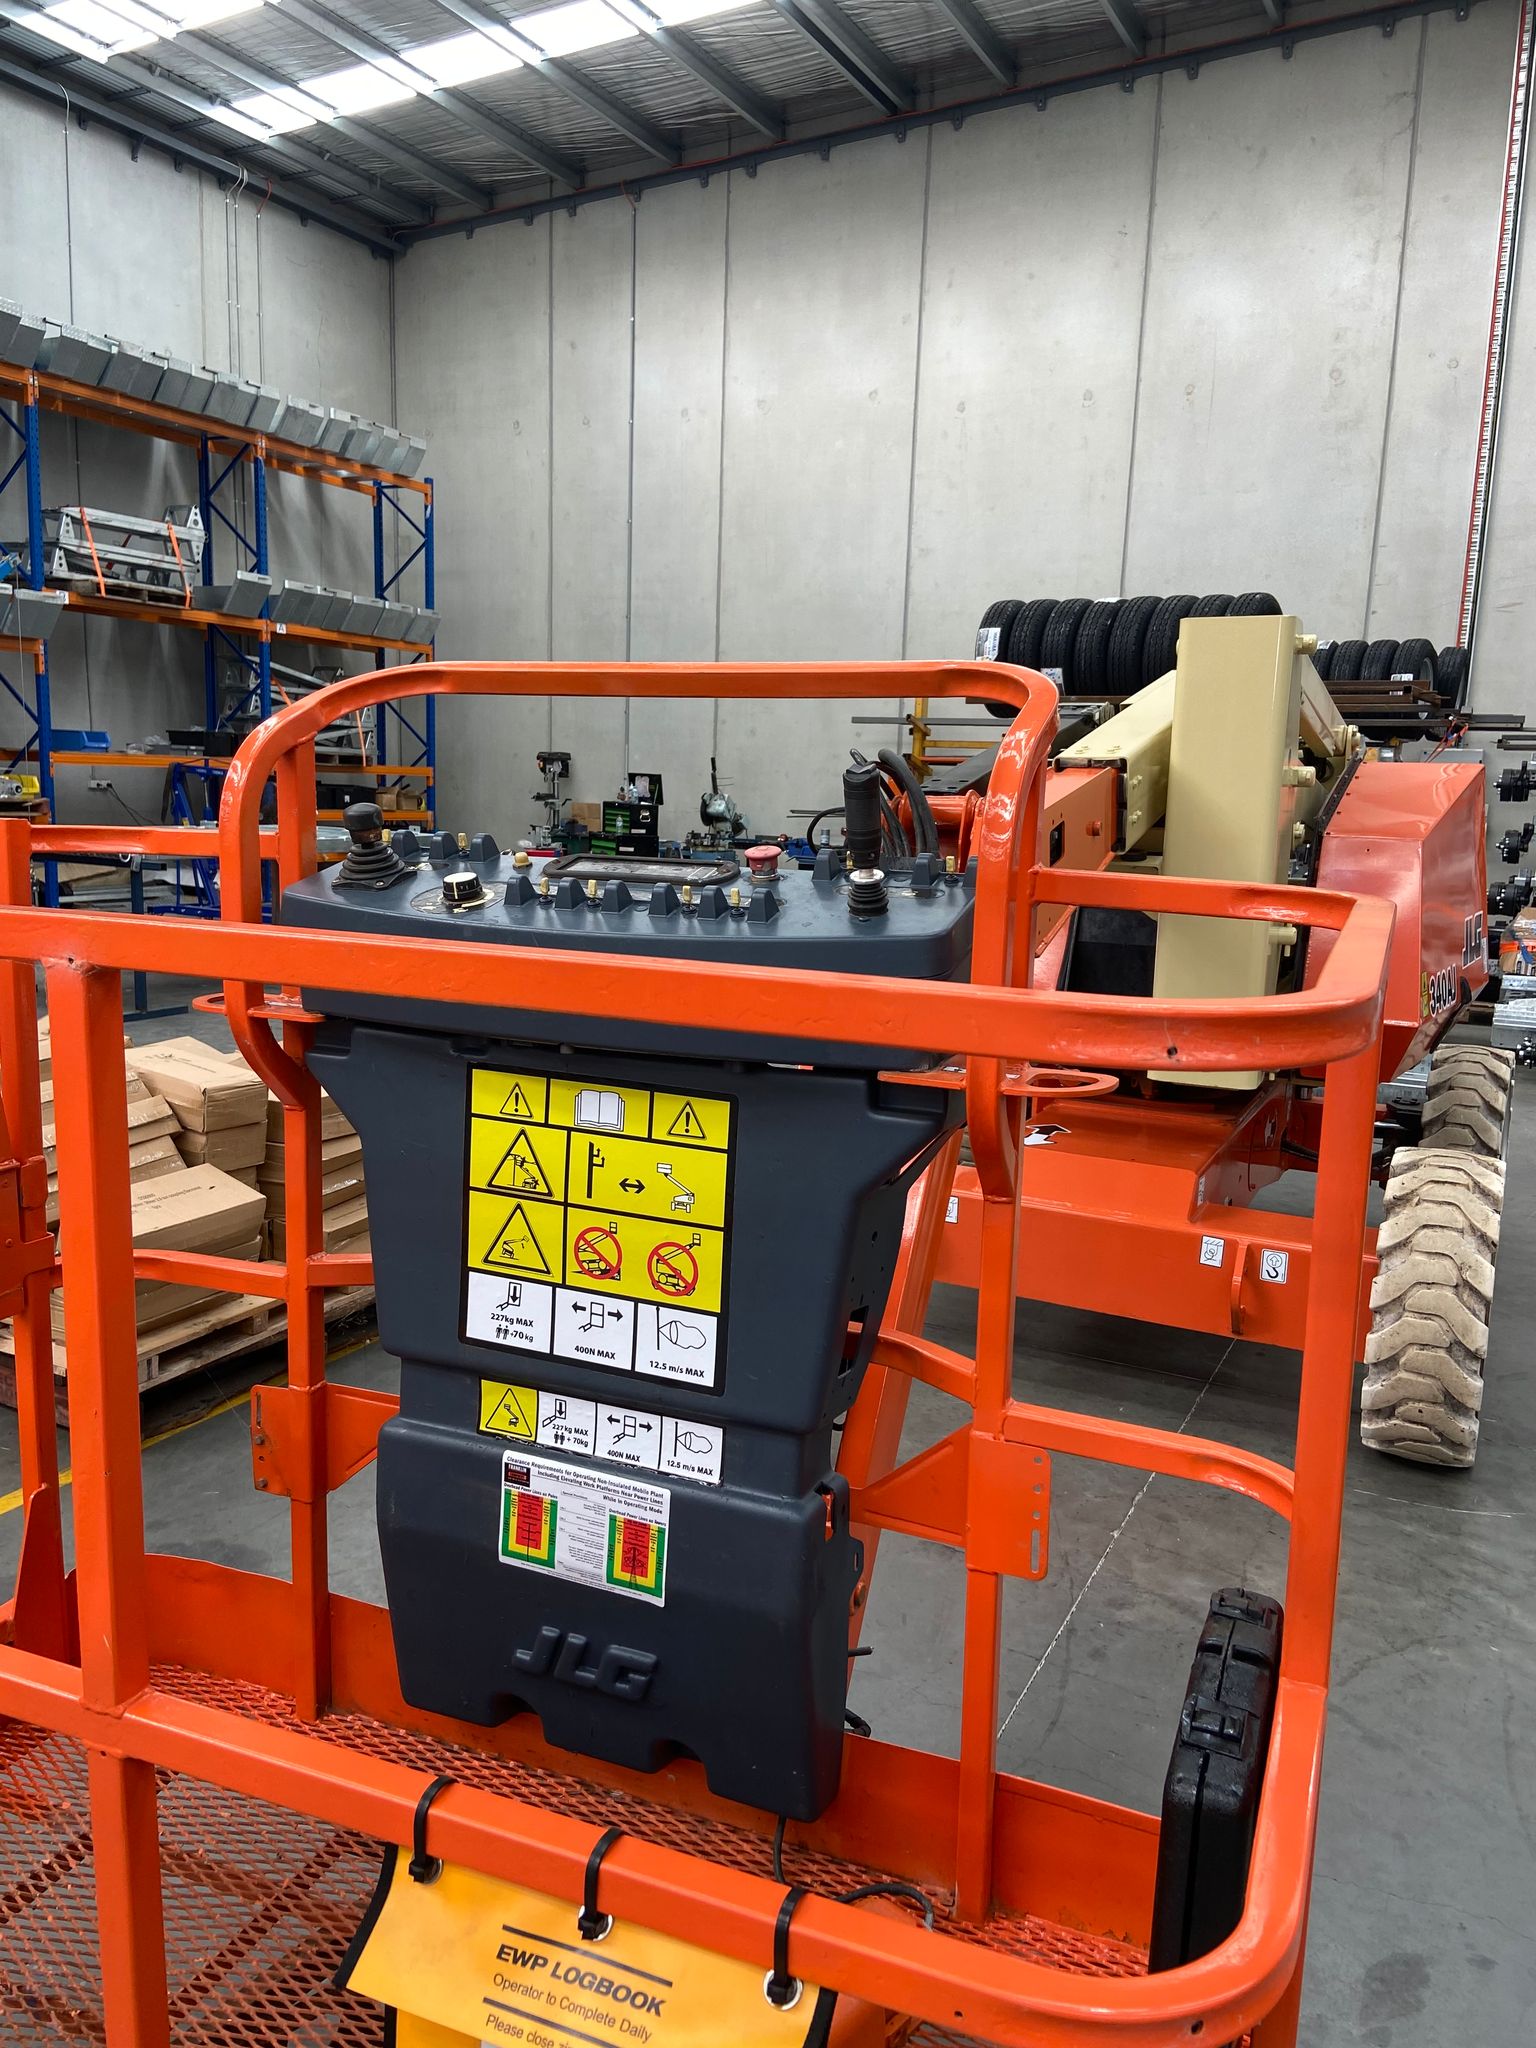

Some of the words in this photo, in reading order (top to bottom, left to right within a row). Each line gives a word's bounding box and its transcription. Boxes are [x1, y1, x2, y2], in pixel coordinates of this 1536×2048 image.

[1461, 910, 1483, 970] JLG
[1429, 963, 1457, 1018] 340AJ
[490, 1312, 515, 1325] 227kg
[515, 1317, 534, 1327] MAX
[574, 1345, 595, 1356] 400N
[597, 1349, 616, 1360] MAX
[649, 1360, 667, 1370] 12.5
[668, 1364, 684, 1374] m/s
[685, 1367, 705, 1378] MAX
[573, 1427, 589, 1437] MAX
[573, 1437, 589, 1447] 70kg
[607, 1449, 624, 1458] 400N
[625, 1453, 641, 1462] MAX
[667, 1460, 681, 1468] 12.5
[682, 1463, 696, 1472] m/s
[696, 1466, 714, 1476] MAX
[506, 1456, 530, 1466] Clearance
[531, 1462, 563, 1474] Requirements
[573, 1472, 597, 1482] Operating
[632, 1486, 651, 1495] Mobile
[651, 1490, 663, 1498] Plant
[538, 1470, 560, 1480] Including
[561, 1476, 582, 1486] Elevating
[583, 1480, 595, 1488] Work
[596, 1483, 620, 1494] Platforms
[634, 1493, 649, 1501] Power
[650, 1497, 663, 1505] Lines
[603, 1495, 617, 1503] While
[624, 1499, 648, 1511] Operating
[649, 1506, 663, 1514] Mode
[511, 1625, 658, 1701] JLG
[496, 1943, 549, 1971] EWP
[550, 1961, 668, 2017] LOGBOOK
[493, 1973, 545, 2001] Operator
[545, 1990, 557, 2006] to
[559, 1995, 616, 2028] Complete
[619, 2018, 653, 2044] Daily
[485, 2013, 524, 2039] Please
[526, 2030, 555, 2048] close
